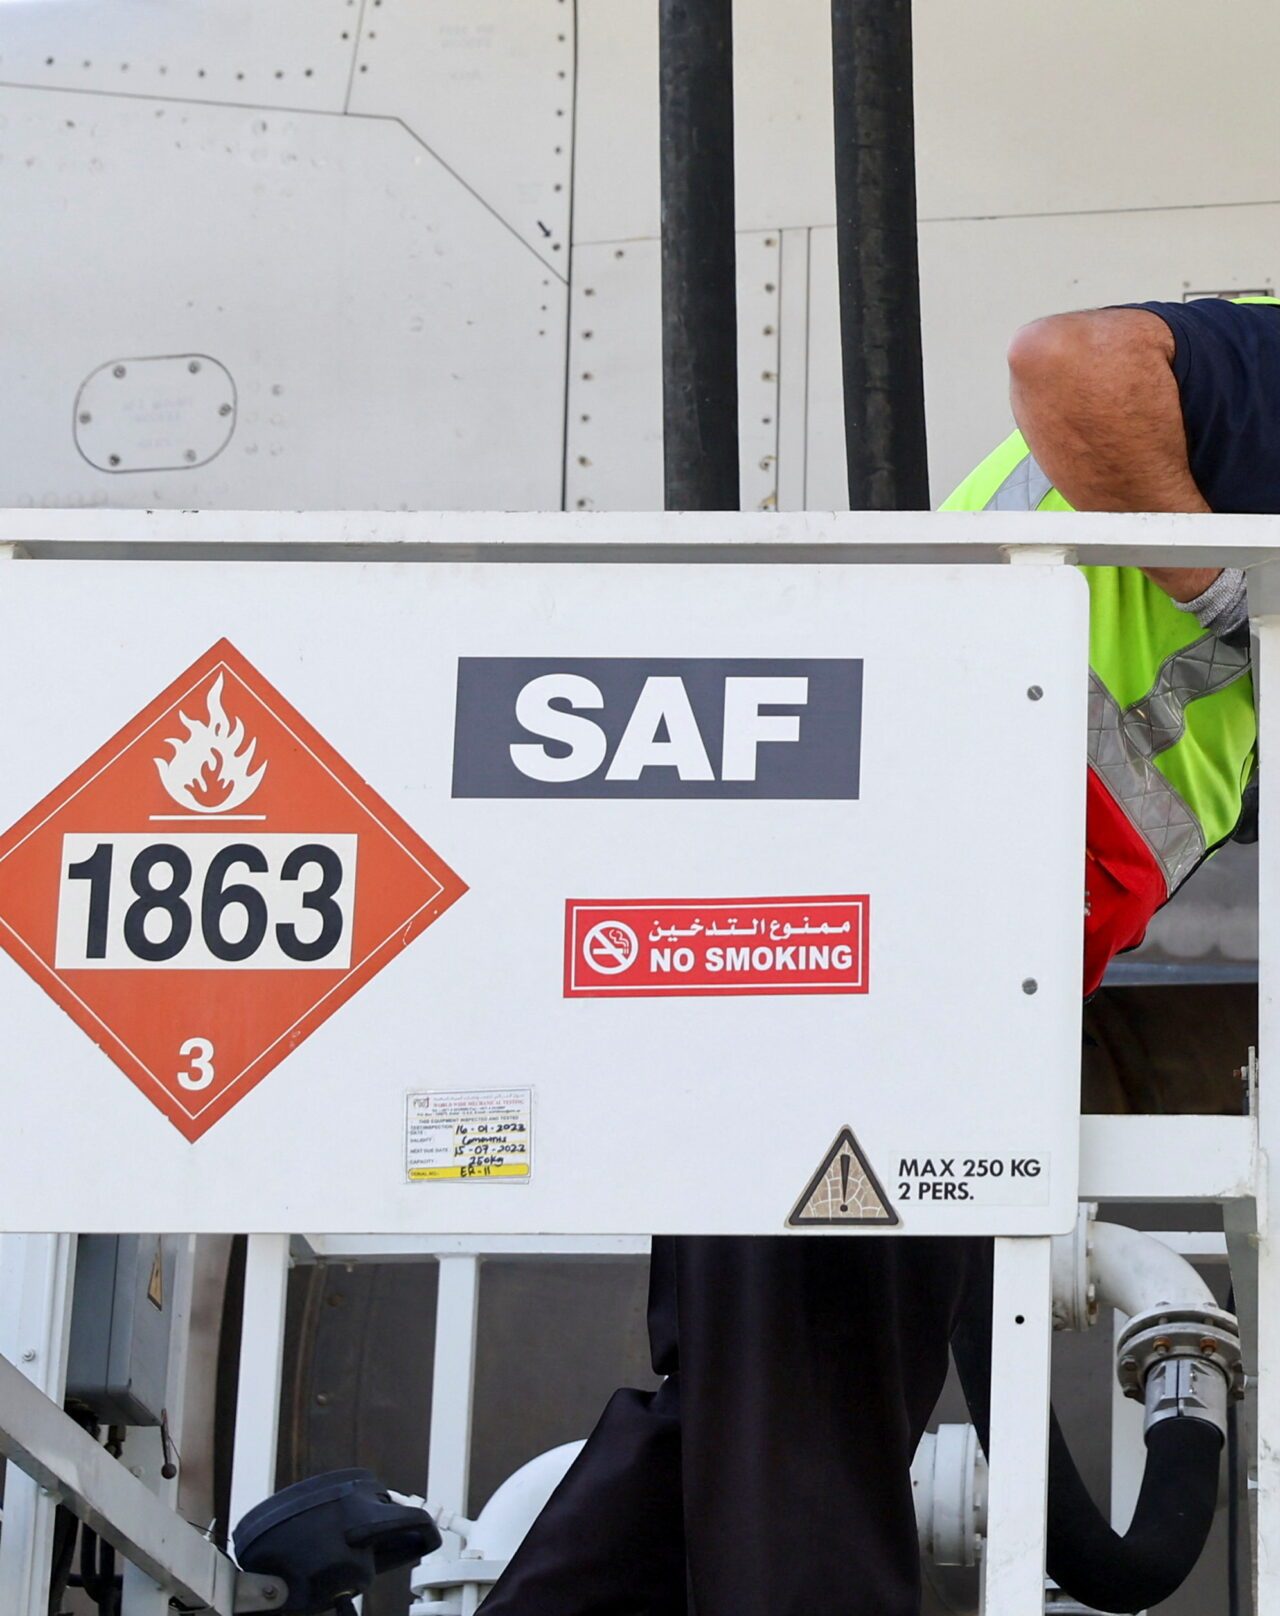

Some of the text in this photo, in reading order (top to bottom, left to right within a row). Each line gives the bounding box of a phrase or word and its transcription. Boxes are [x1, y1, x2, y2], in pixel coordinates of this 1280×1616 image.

[509, 673, 809, 783] SAF
[68, 843, 343, 962] 1863
[648, 915, 851, 942] ممنوع التدخين
[650, 944, 853, 973] NO SMOKING
[177, 1037, 215, 1091] 3
[898, 1158, 1041, 1178] MAX 250 KG
[898, 1181, 975, 1201] 2 PERS.
